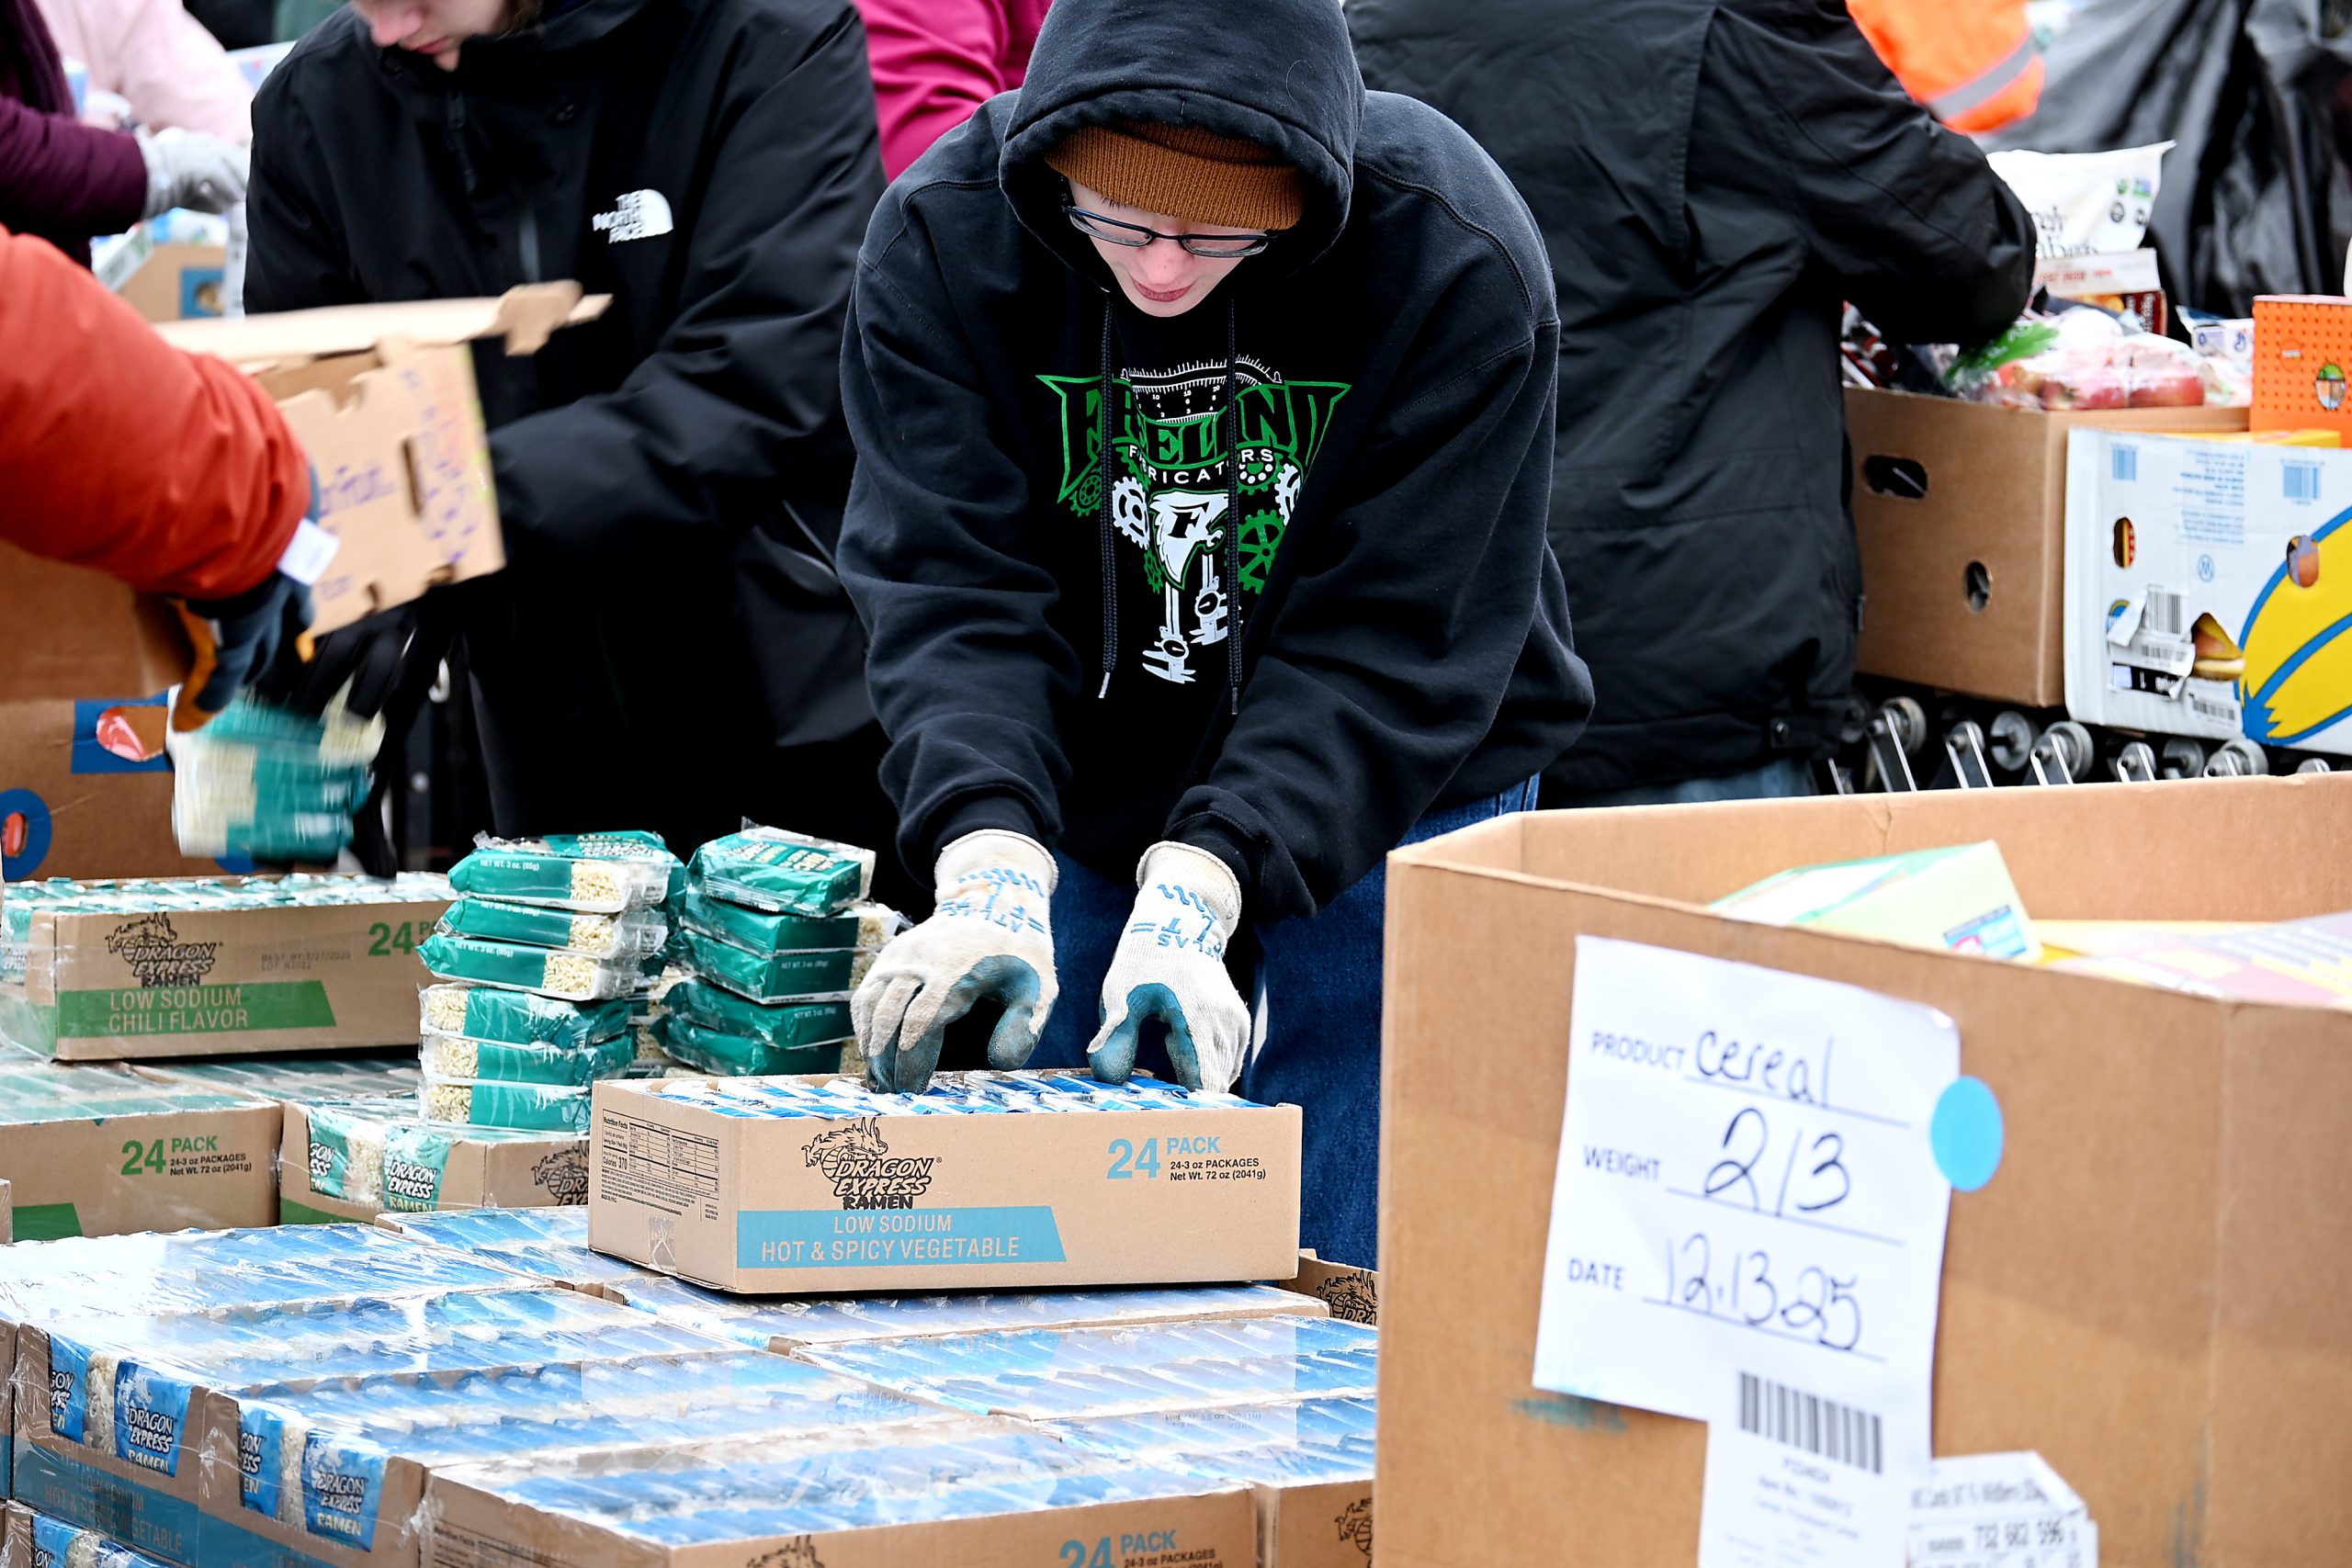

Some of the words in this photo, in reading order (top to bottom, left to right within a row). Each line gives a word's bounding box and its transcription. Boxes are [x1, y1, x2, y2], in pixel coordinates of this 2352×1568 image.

[616, 189, 642, 211] THE
[593, 211, 643, 231] NORTH
[608, 223, 643, 243] FACE
[481, 859, 492, 867] NET
[368, 921, 414, 955] 24
[133, 942, 217, 962] DRAGON
[133, 957, 215, 977] EXPRESS
[141, 974, 200, 988] RAMEN
[110, 991, 154, 1011] LOW
[161, 987, 242, 1010] SODIUM
[108, 1011, 163, 1033] CHILI
[170, 1010, 248, 1032] FLAVOR
[1590, 1030, 1687, 1072] PRODUCT
[120, 1139, 166, 1176] 24
[172, 1135, 219, 1154] PACK
[170, 1158, 187, 1167] 24-3
[200, 1153, 246, 1164] PACKAGES
[1106, 1137, 1161, 1180] 24
[1167, 1136, 1221, 1155] PACK
[1170, 1160, 1190, 1170] 24-3
[1193, 1161, 1203, 1169] oz
[1205, 1158, 1260, 1168] PACKAGES
[1584, 1145, 1663, 1182] WEIGHT
[1704, 1108, 1851, 1218] 213
[170, 1168, 184, 1176] Net
[186, 1167, 198, 1175] Wt.
[223, 1162, 252, 1173] (2041g)
[390, 1160, 437, 1184] DRAGON
[834, 1157, 934, 1178] DRAGON
[1170, 1171, 1186, 1181] Net
[1188, 1171, 1204, 1180] Wt.
[1205, 1170, 1216, 1179] 72
[1219, 1171, 1230, 1179] oz
[1232, 1168, 1266, 1180] (2041g)
[388, 1177, 435, 1200] EXPRESS
[833, 1176, 932, 1196] EXPRESS
[389, 1196, 432, 1213] RAMEN
[842, 1195, 913, 1211] RAMEN
[833, 1216, 874, 1234] LOW
[879, 1214, 953, 1233] SODIUM
[762, 1241, 805, 1262] HOT
[811, 1242, 824, 1261] &
[831, 1239, 899, 1261] SPICY
[900, 1236, 1020, 1258] VEGETABLE
[1568, 1258, 1626, 1292] DATE
[129, 1406, 175, 1434] DRAGON
[130, 1427, 174, 1454] EXPRESS
[128, 1450, 170, 1472] RAMEN
[318, 1472, 365, 1495] DRAGON
[119, 1514, 183, 1555] GETABLE
[317, 1512, 362, 1537] RAMEN
[1059, 1537, 1116, 1568] 24
[1120, 1529, 1176, 1555] PACK
[1160, 1549, 1216, 1564] PACKAGES
